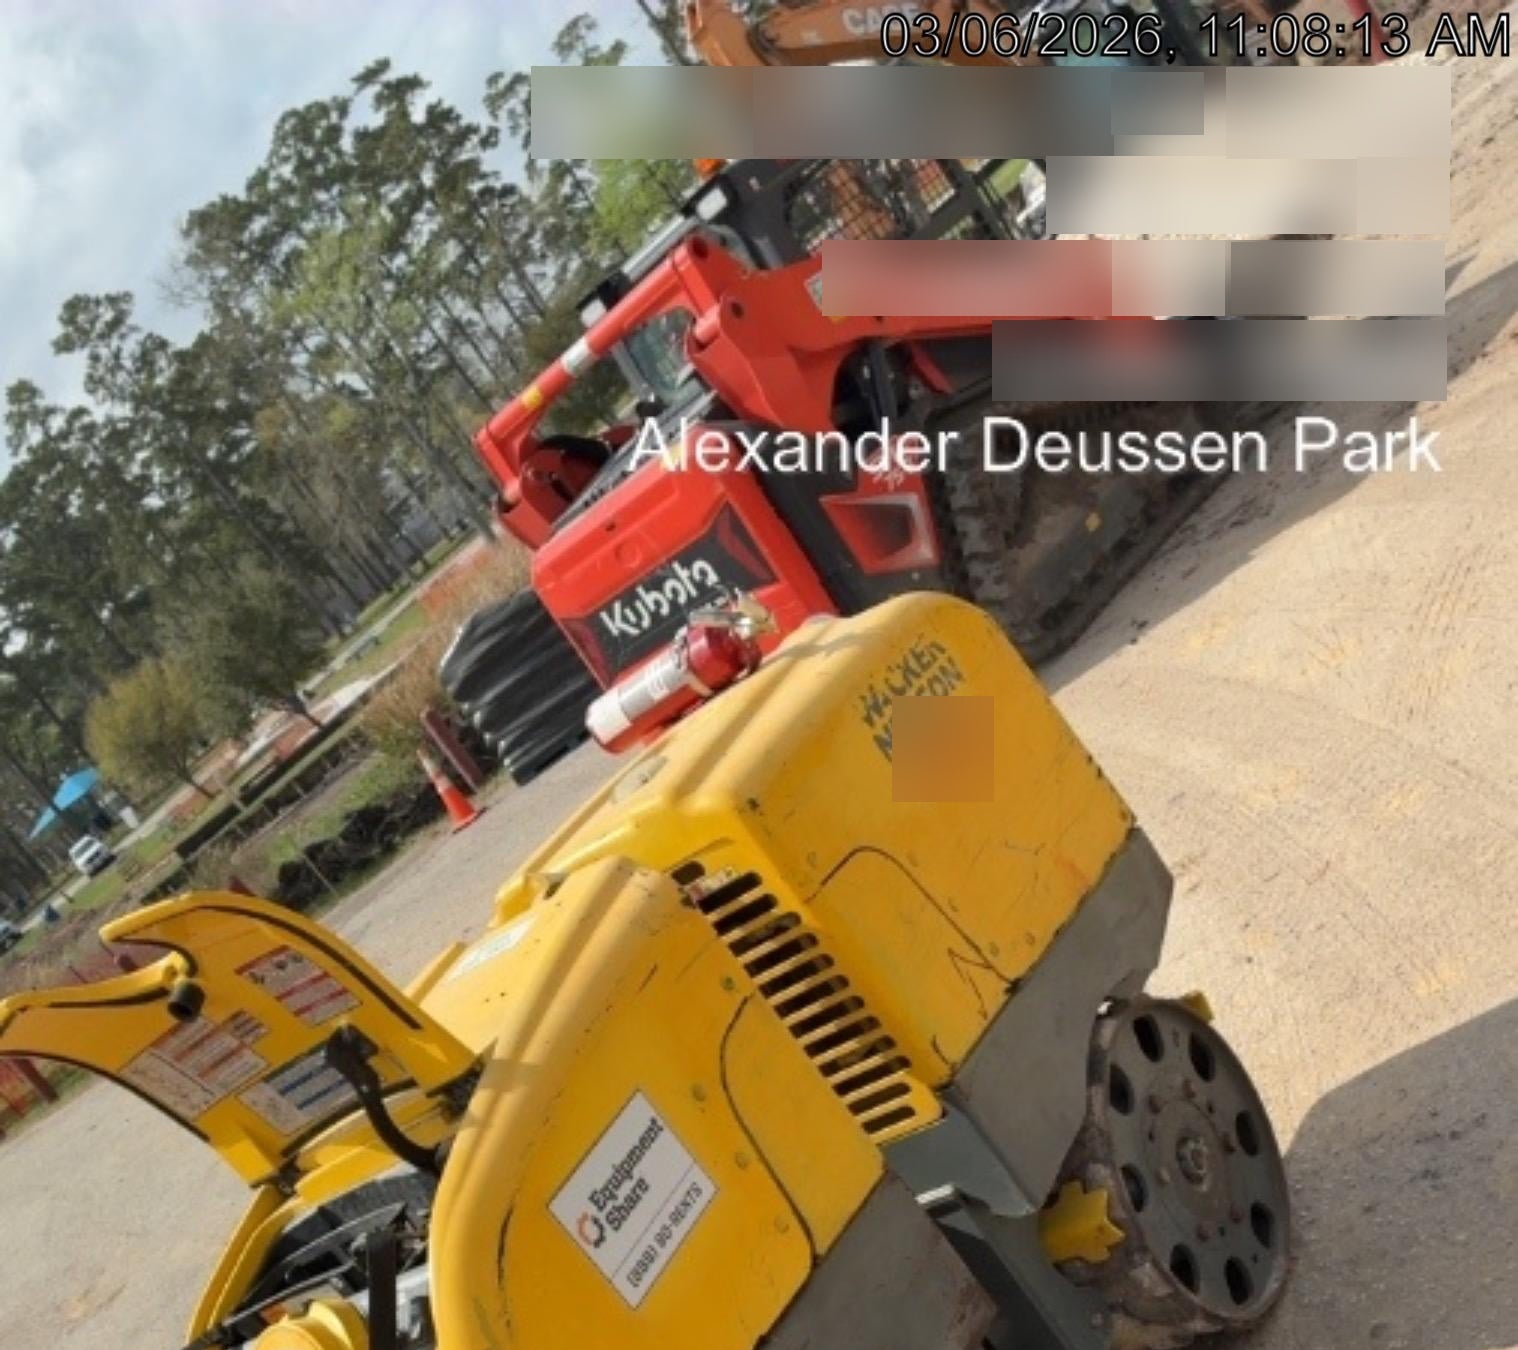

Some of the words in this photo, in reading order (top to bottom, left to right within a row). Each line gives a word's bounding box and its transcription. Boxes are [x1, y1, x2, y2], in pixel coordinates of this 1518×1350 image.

[600, 558, 718, 636] Kubota
[589, 1117, 664, 1211] Equipment
[606, 1178, 649, 1232] Share
